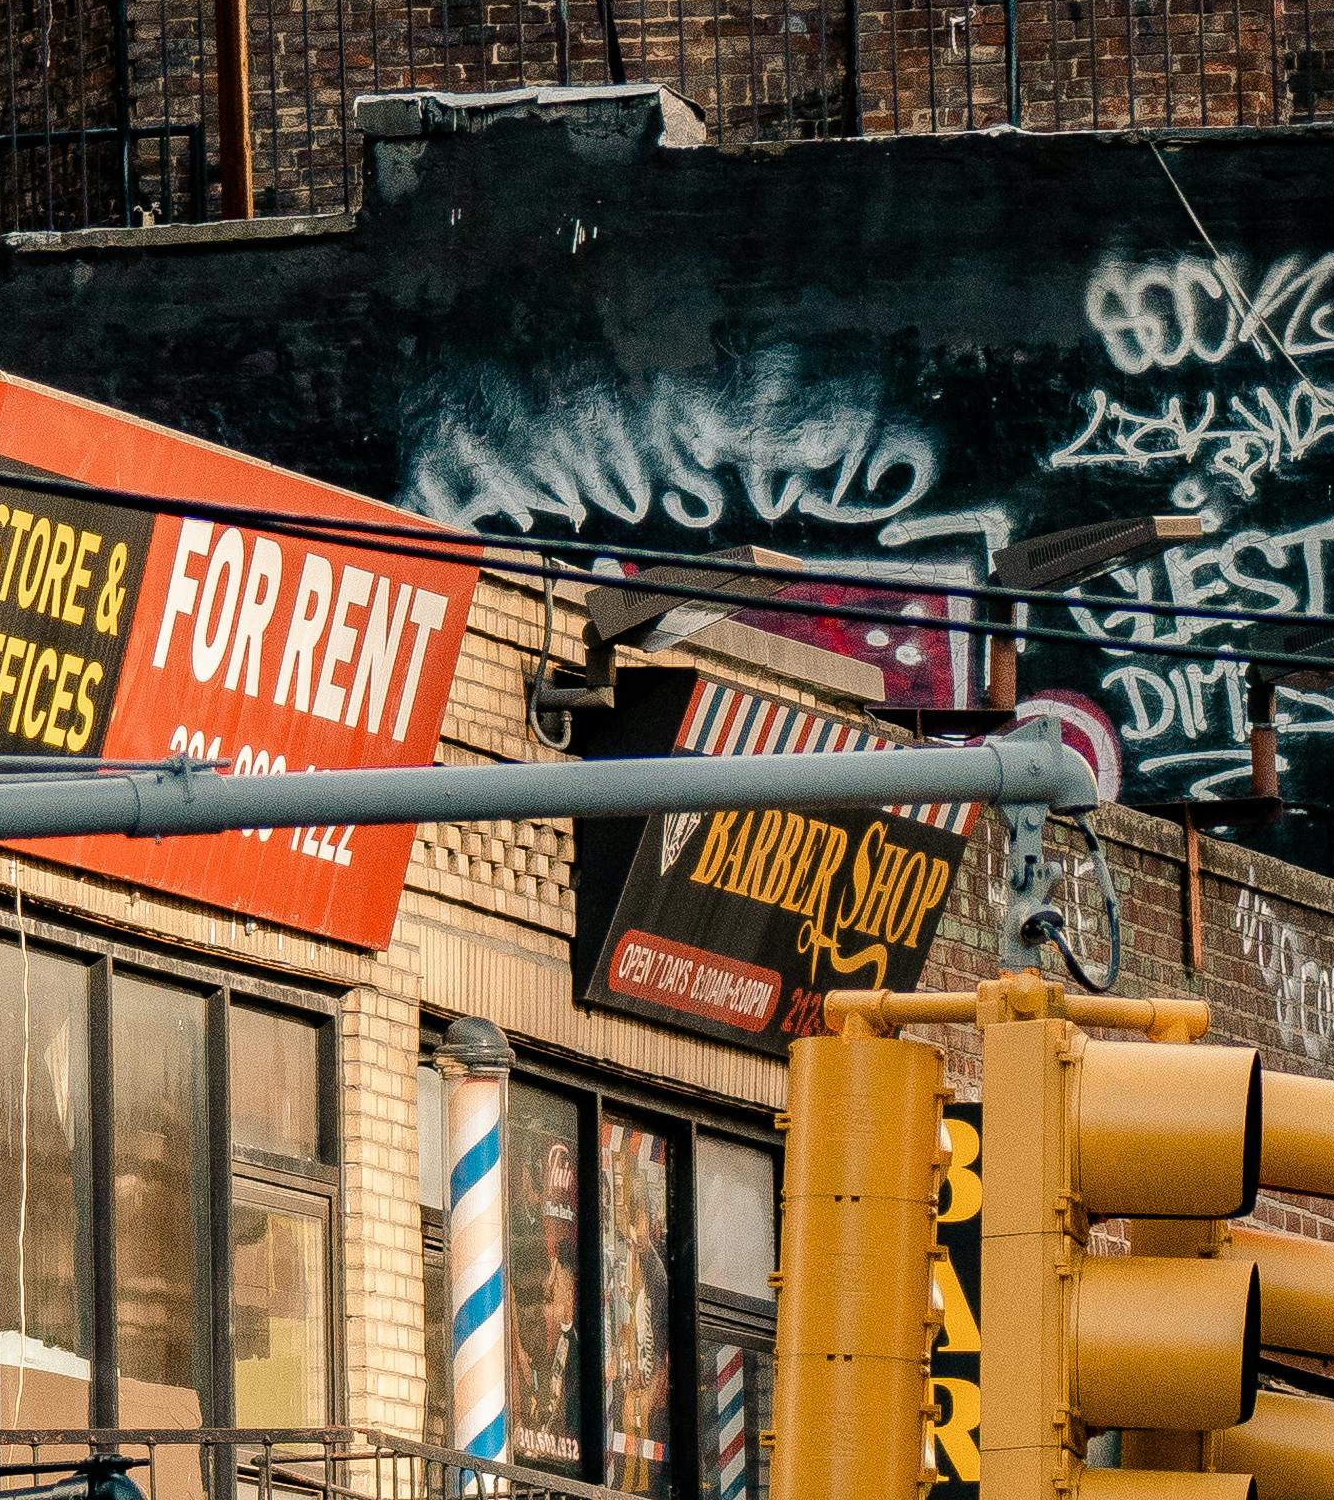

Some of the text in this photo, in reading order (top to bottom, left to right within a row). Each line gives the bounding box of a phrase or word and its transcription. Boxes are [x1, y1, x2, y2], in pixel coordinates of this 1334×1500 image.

[95, 541, 128, 636] &
[153, 516, 449, 744] FOR RENT
[690, 809, 849, 921] BARBER
[839, 821, 951, 948] SHOP
[619, 943, 650, 984] OPEN
[659, 953, 692, 995] DAYS
